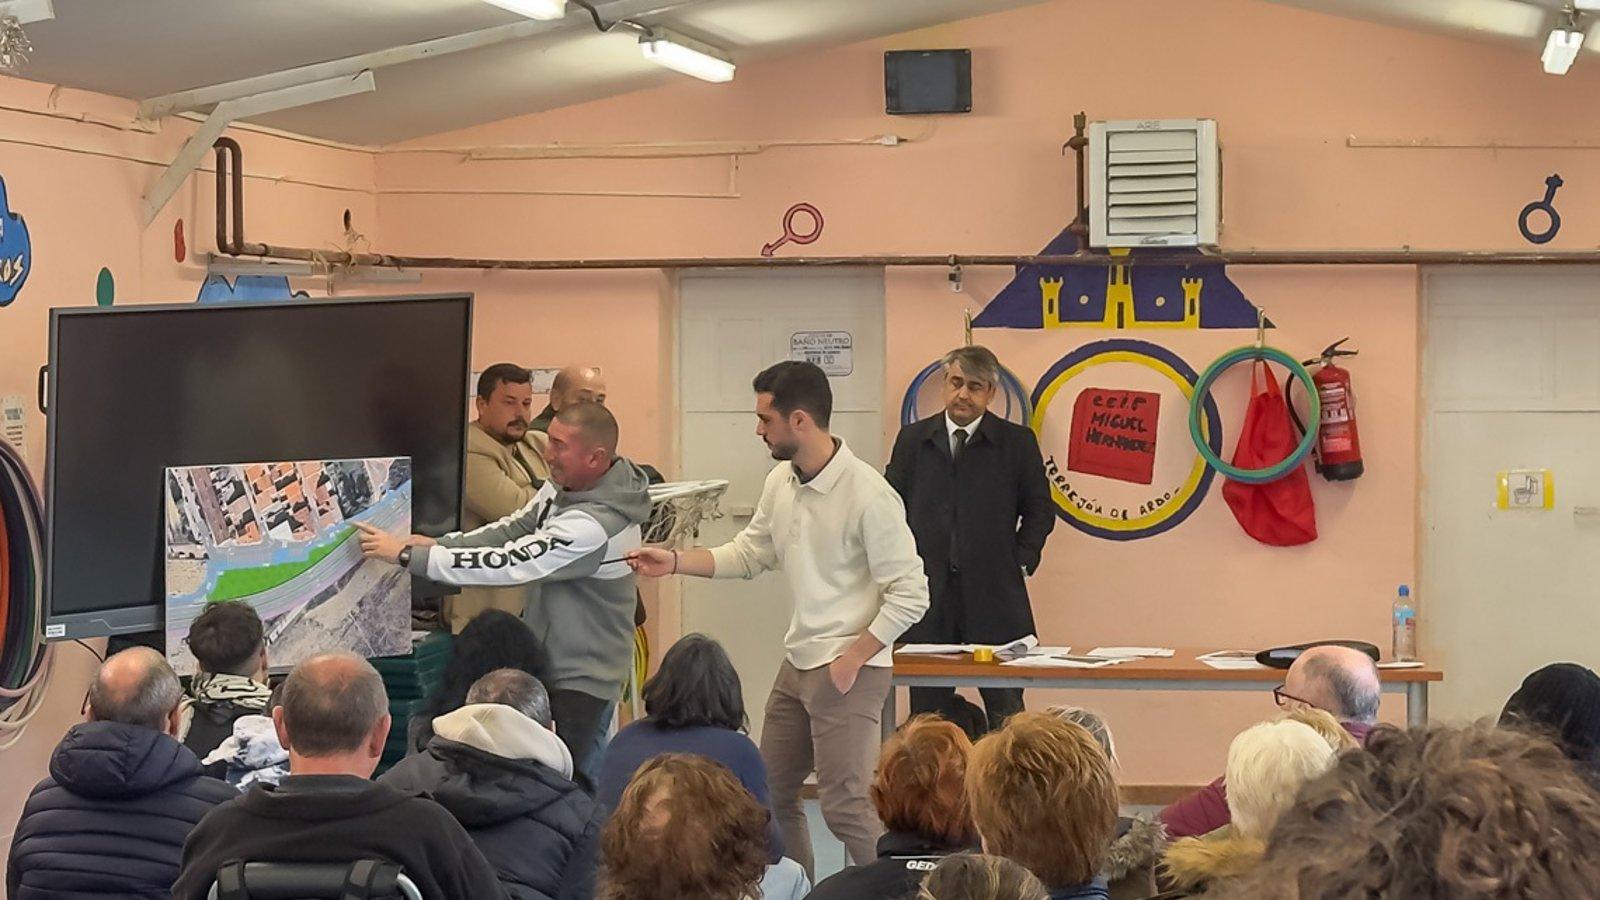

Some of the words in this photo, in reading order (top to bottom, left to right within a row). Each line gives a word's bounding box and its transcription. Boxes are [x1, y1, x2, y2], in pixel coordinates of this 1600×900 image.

[1090, 412, 1148, 433] MIGUEL
[1110, 508, 1128, 520] DE
[451, 537, 574, 569] HONDA
